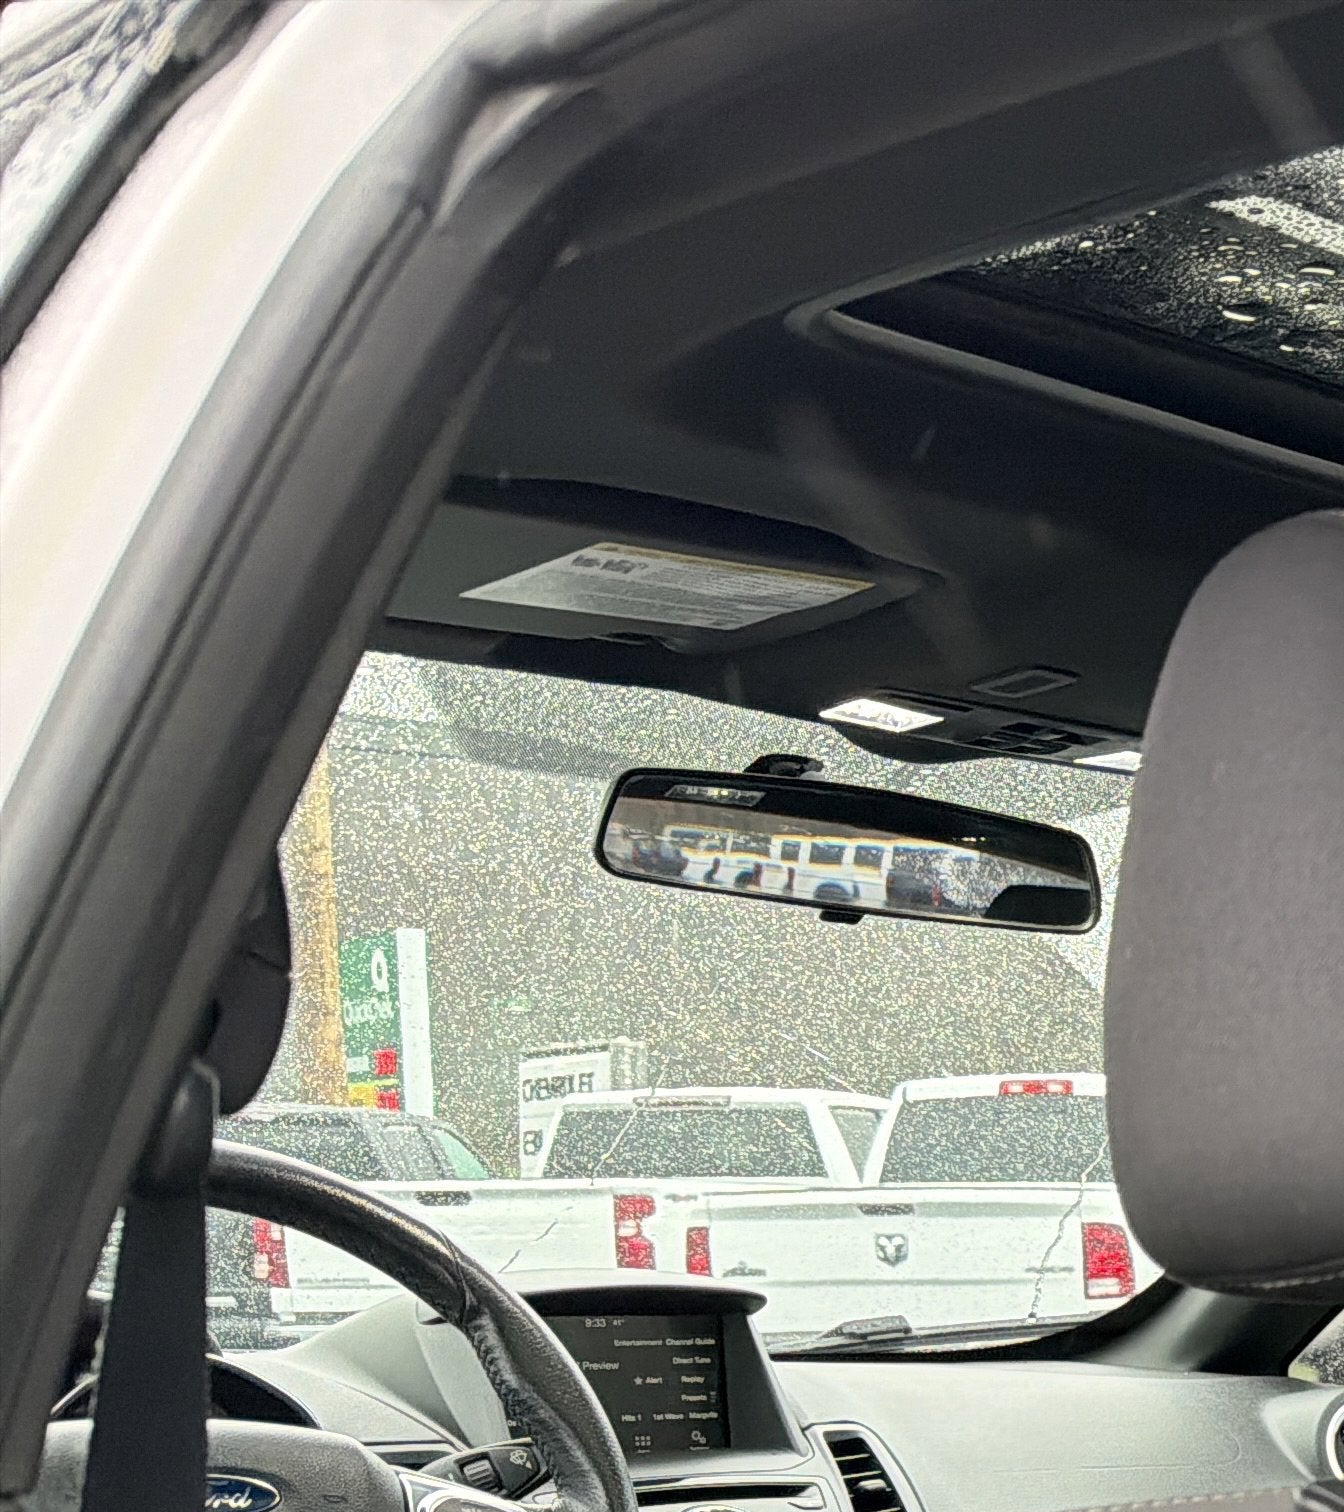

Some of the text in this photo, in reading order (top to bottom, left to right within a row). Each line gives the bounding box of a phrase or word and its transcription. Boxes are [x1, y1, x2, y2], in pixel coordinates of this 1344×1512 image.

[585, 1318, 606, 1328] 9:33
[614, 1338, 663, 1347] Entertainment
[665, 1336, 716, 1346] Channel Guide
[672, 1356, 711, 1364] Direct Tune
[582, 1360, 620, 1371] Preview
[645, 1376, 663, 1384] Alert
[681, 1375, 705, 1384] Replay
[681, 1394, 707, 1402] Presets
[653, 1412, 684, 1421] 1st Wave
